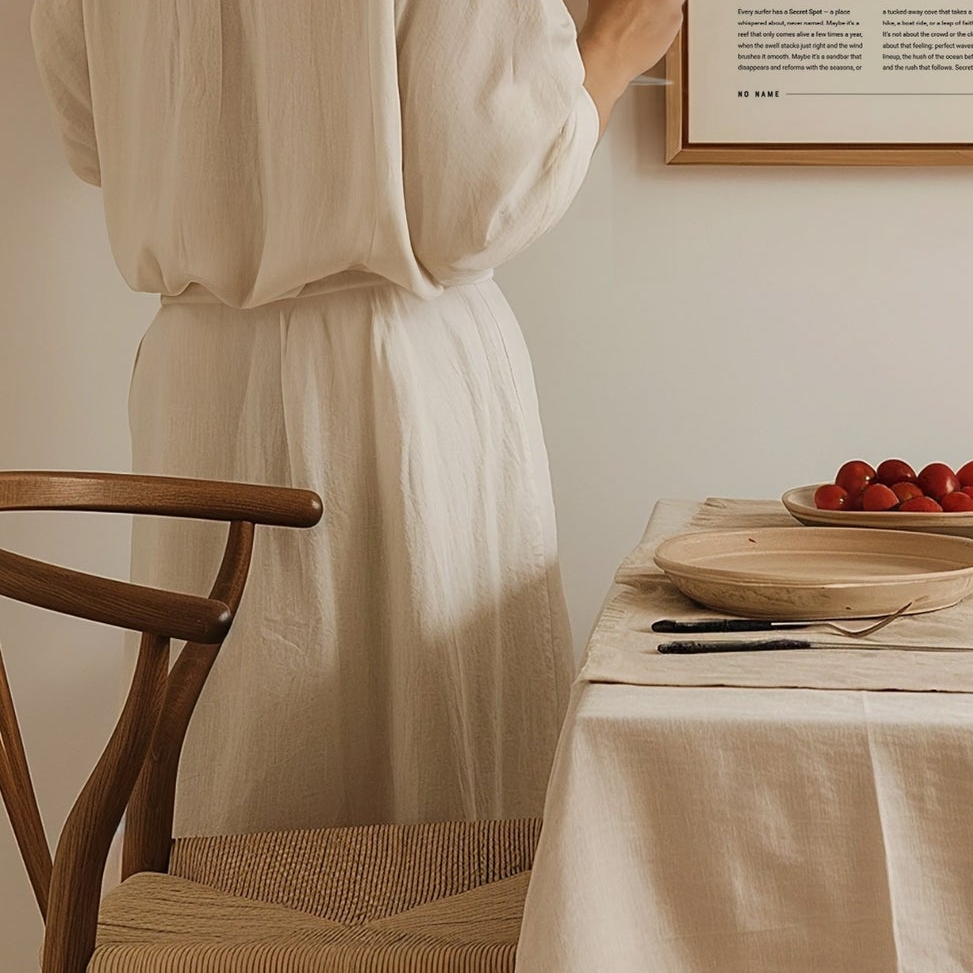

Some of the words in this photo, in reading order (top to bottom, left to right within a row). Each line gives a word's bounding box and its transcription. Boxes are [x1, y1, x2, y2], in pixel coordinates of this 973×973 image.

[738, 8, 754, 16] Every
[808, 8, 822, 16] Spot
[762, 31, 775, 39] only
[934, 42, 955, 50] perfect
[738, 64, 769, 72] disappears
[737, 90, 749, 98] NO
[755, 90, 780, 98] NAME
